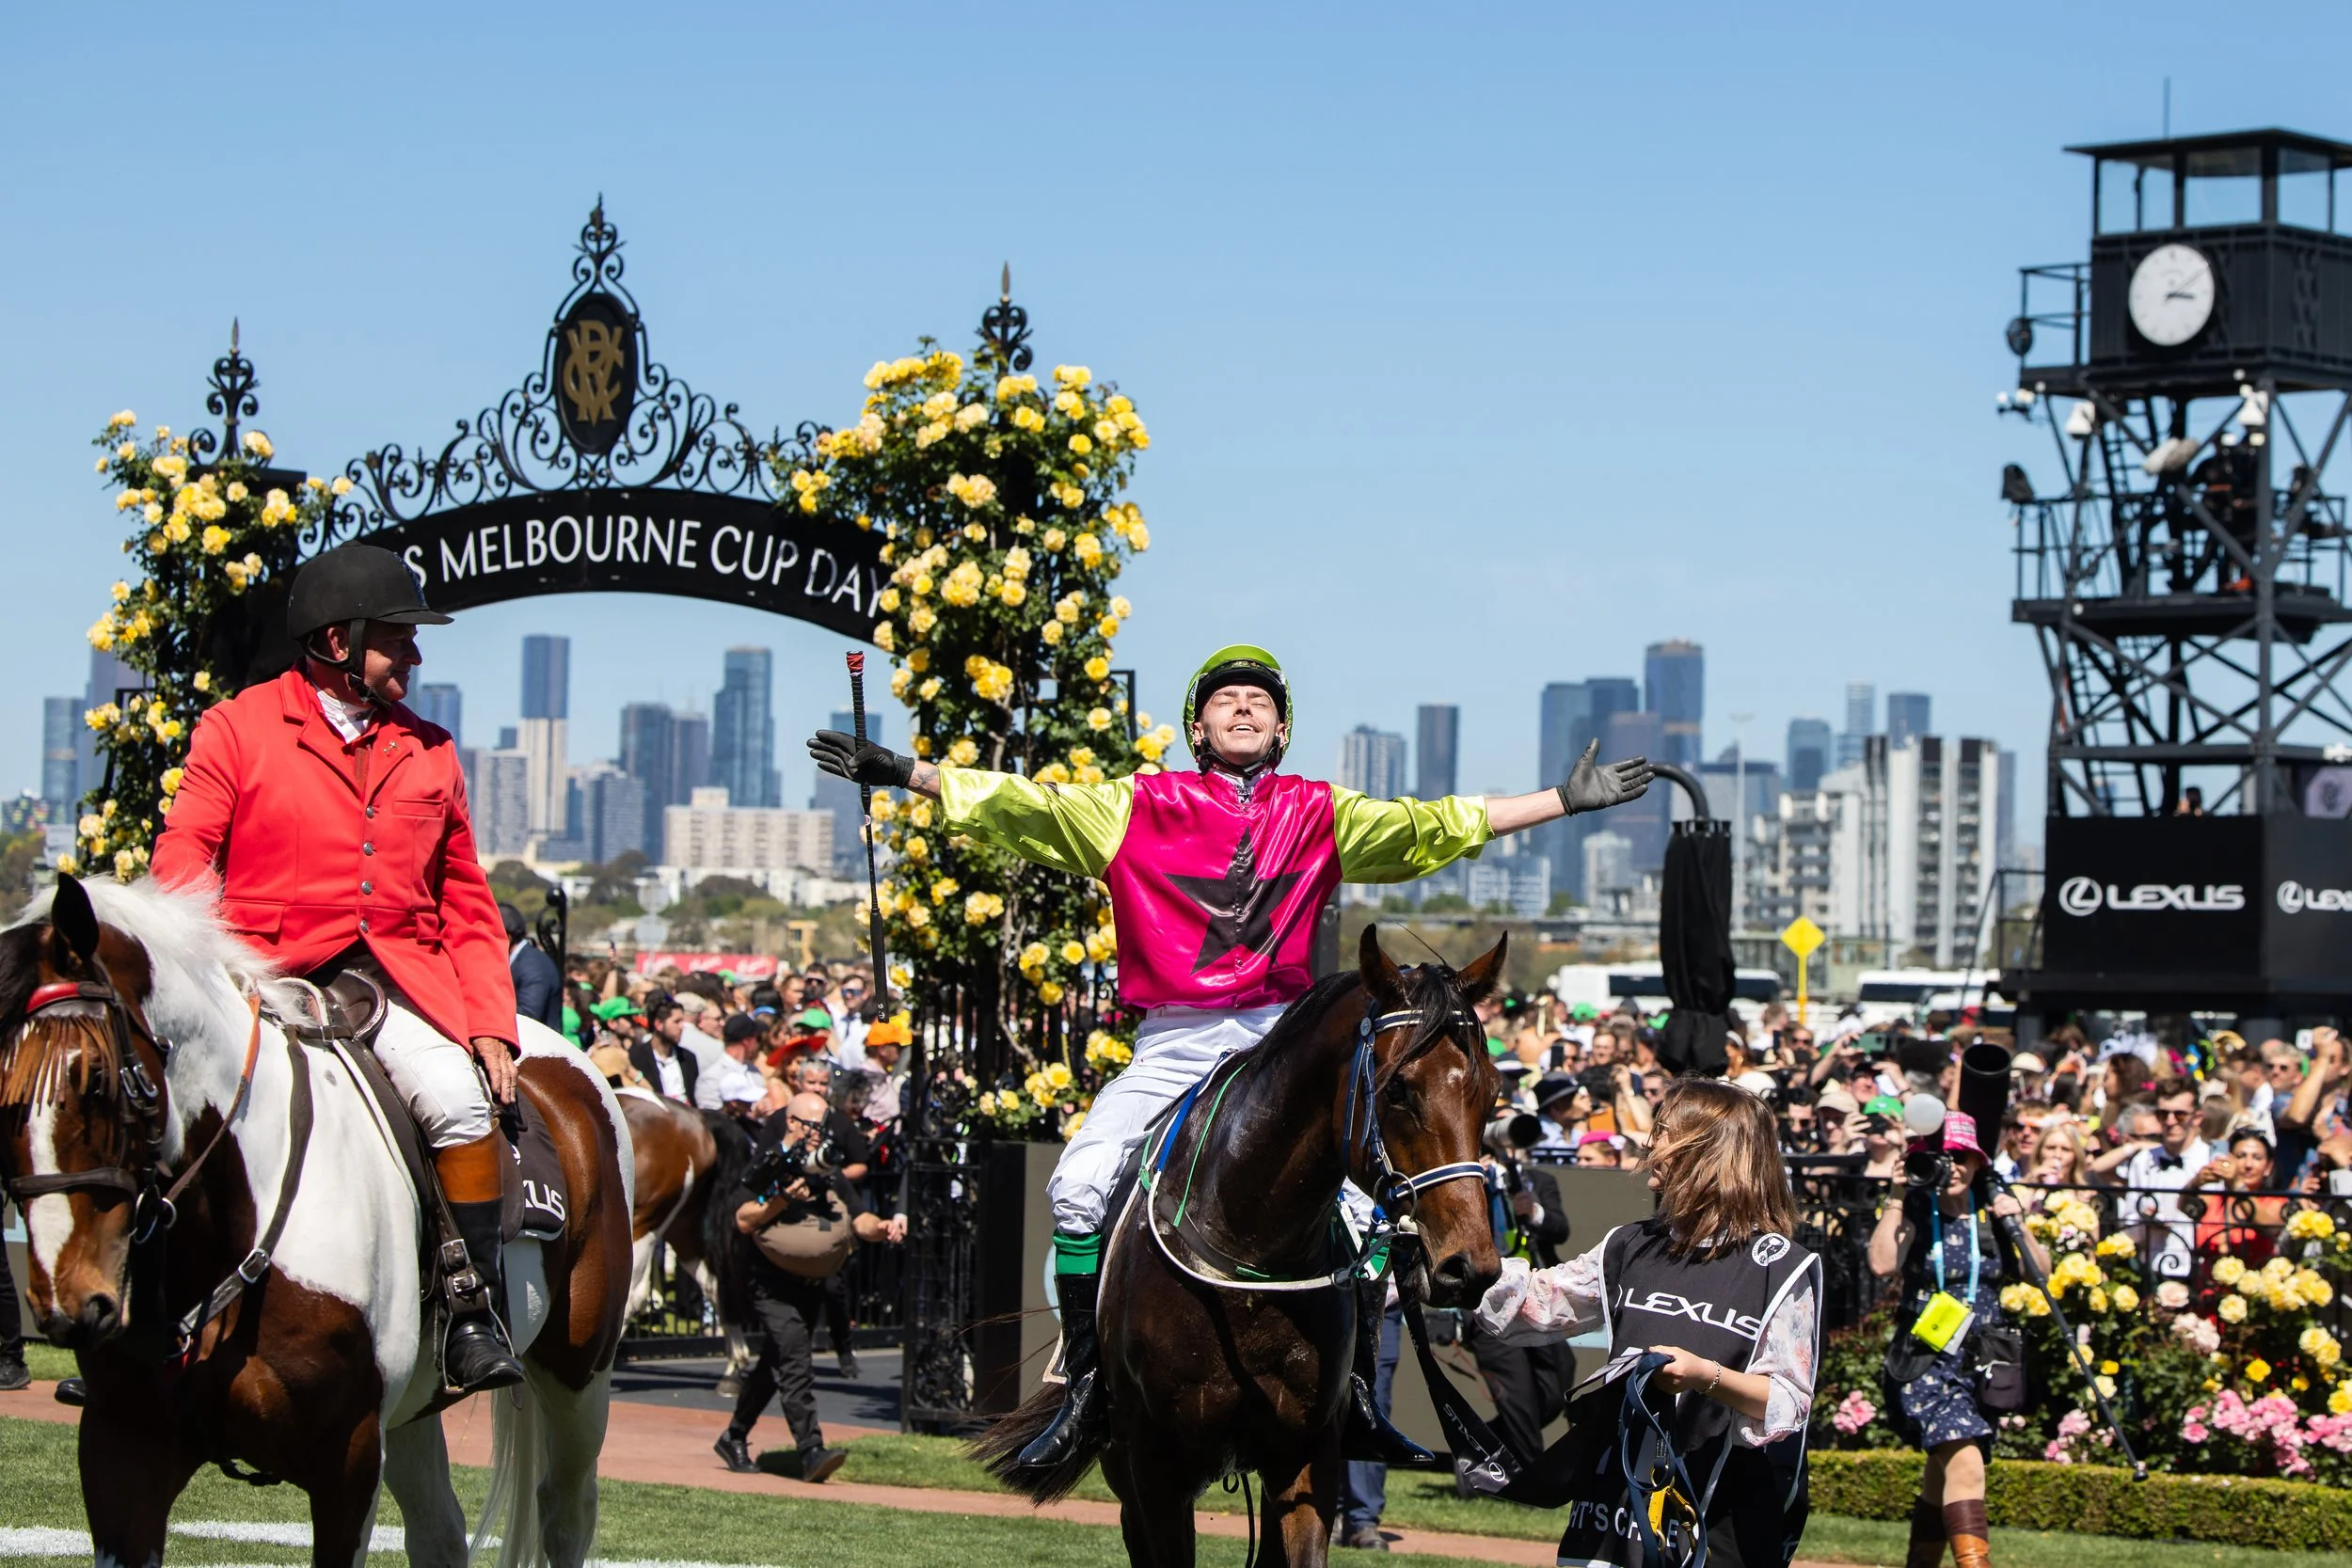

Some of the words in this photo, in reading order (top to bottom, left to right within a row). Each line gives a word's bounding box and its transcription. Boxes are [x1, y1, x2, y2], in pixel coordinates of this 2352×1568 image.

[439, 515, 698, 582] MELBOURNE
[710, 525, 799, 586] CUP
[804, 547, 894, 619] DAY
[2106, 884, 2247, 911] LEXUS
[1624, 1287, 1761, 1341] LEXUS
[1442, 1402, 1491, 1463] LEXUS
